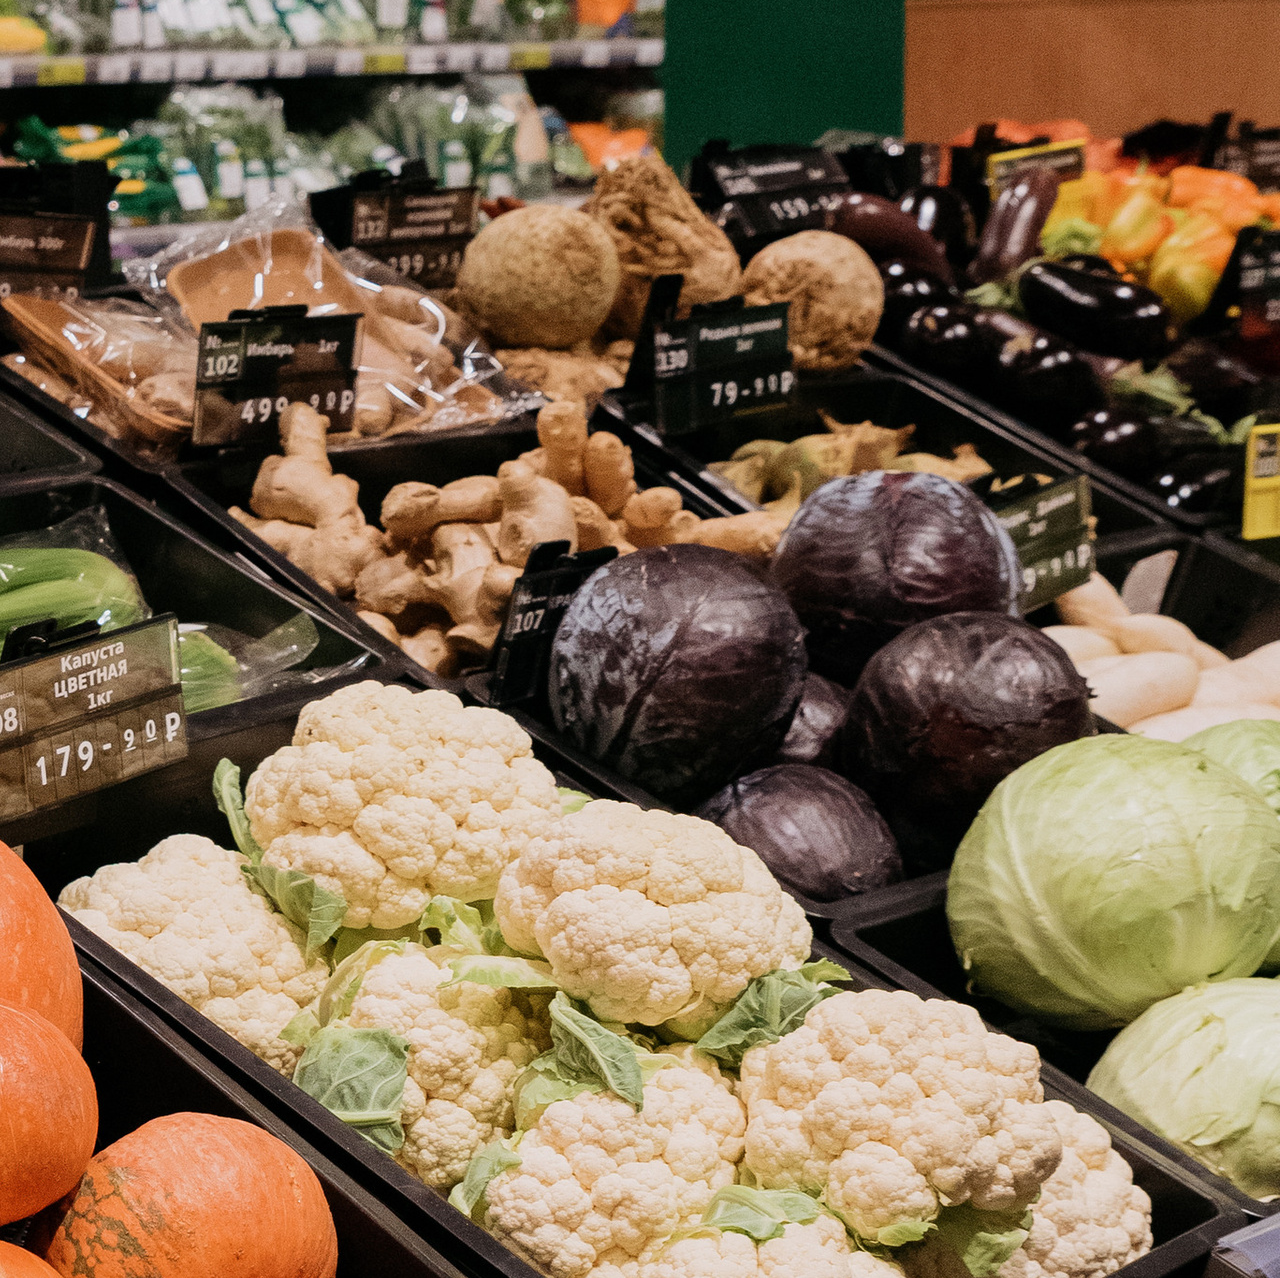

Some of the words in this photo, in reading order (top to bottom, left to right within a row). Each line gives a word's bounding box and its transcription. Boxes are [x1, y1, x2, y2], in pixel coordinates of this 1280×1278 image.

[247, 343, 295, 358] Имбирь
[204, 354, 239, 377] 102
[512, 609, 545, 634] 107
[60, 641, 125, 673] Капуста
[54, 659, 128, 698] ЦВЕТНАЯ
[87, 690, 113, 710] 1кг
